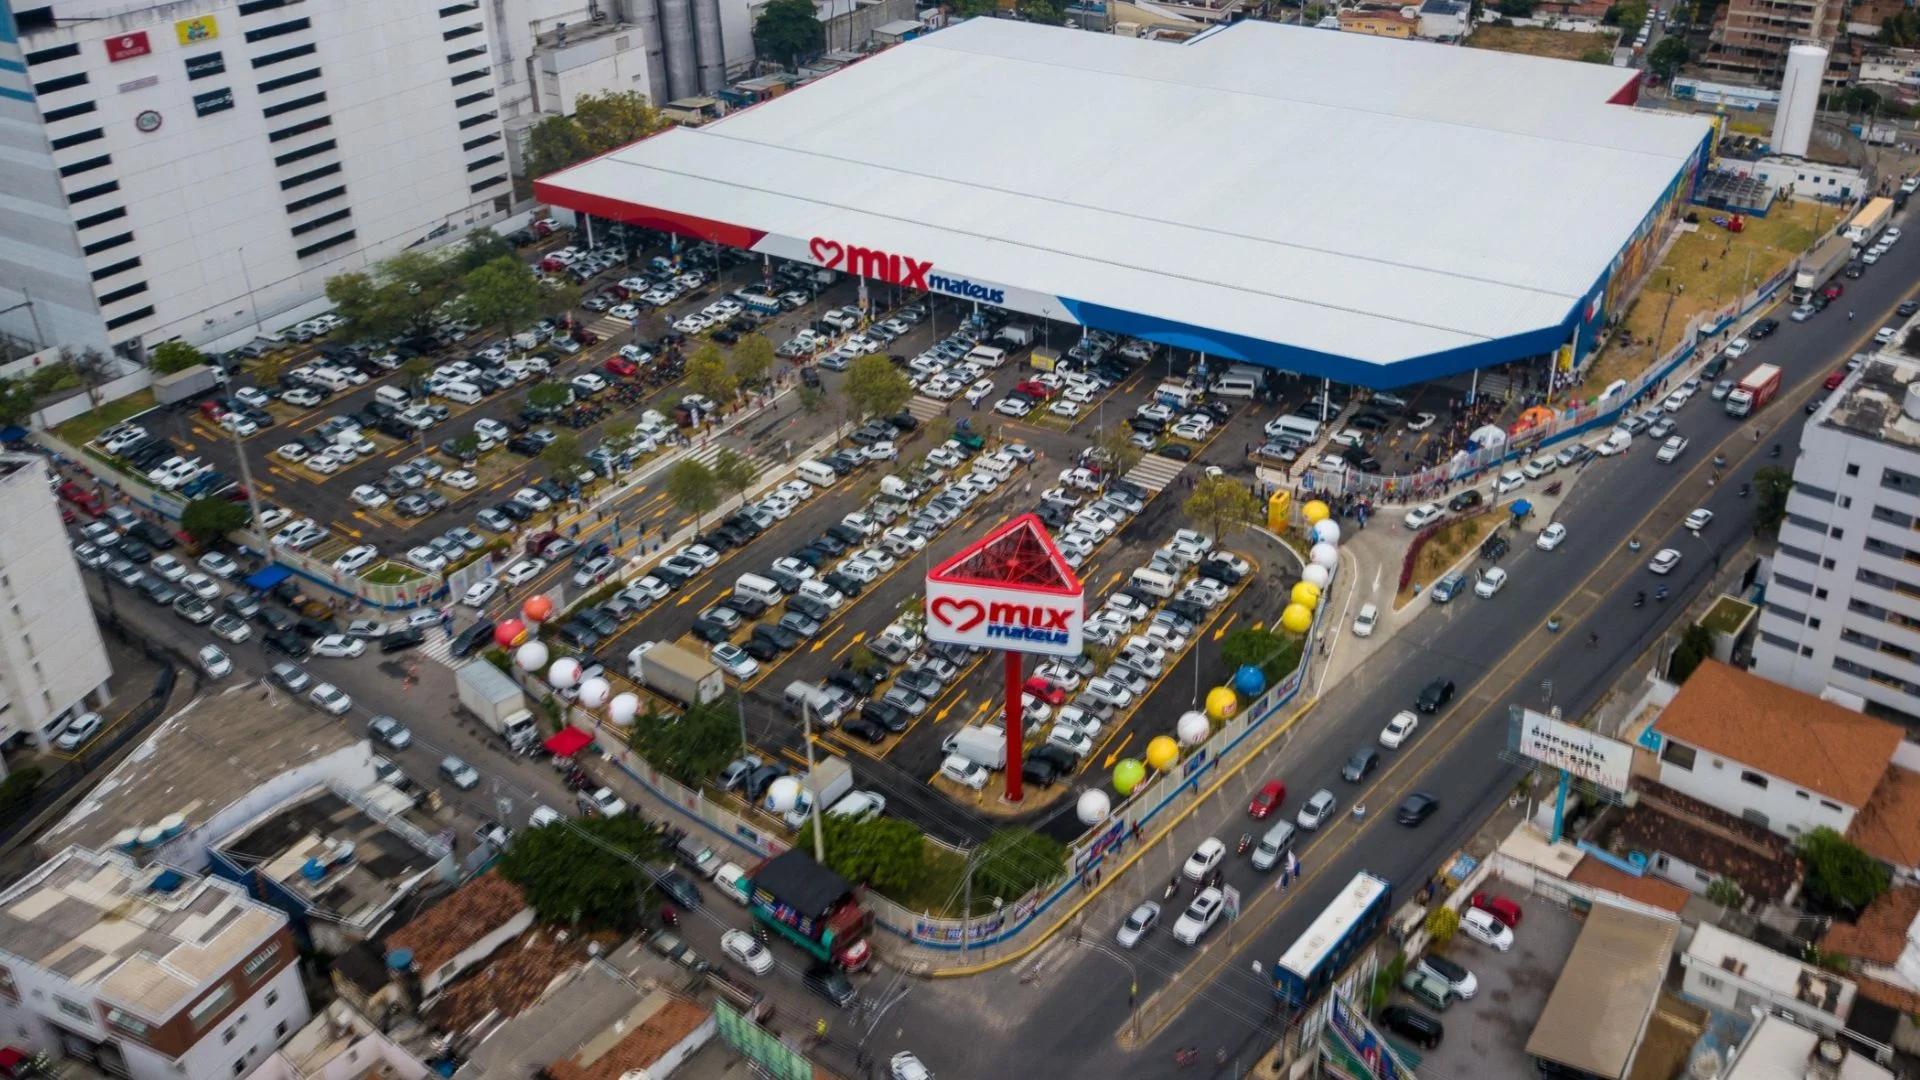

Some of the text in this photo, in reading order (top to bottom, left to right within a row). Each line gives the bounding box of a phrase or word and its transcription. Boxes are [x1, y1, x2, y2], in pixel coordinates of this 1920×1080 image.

[847, 244, 1005, 305] mix mateus
[987, 601, 1076, 646] mix mateus
